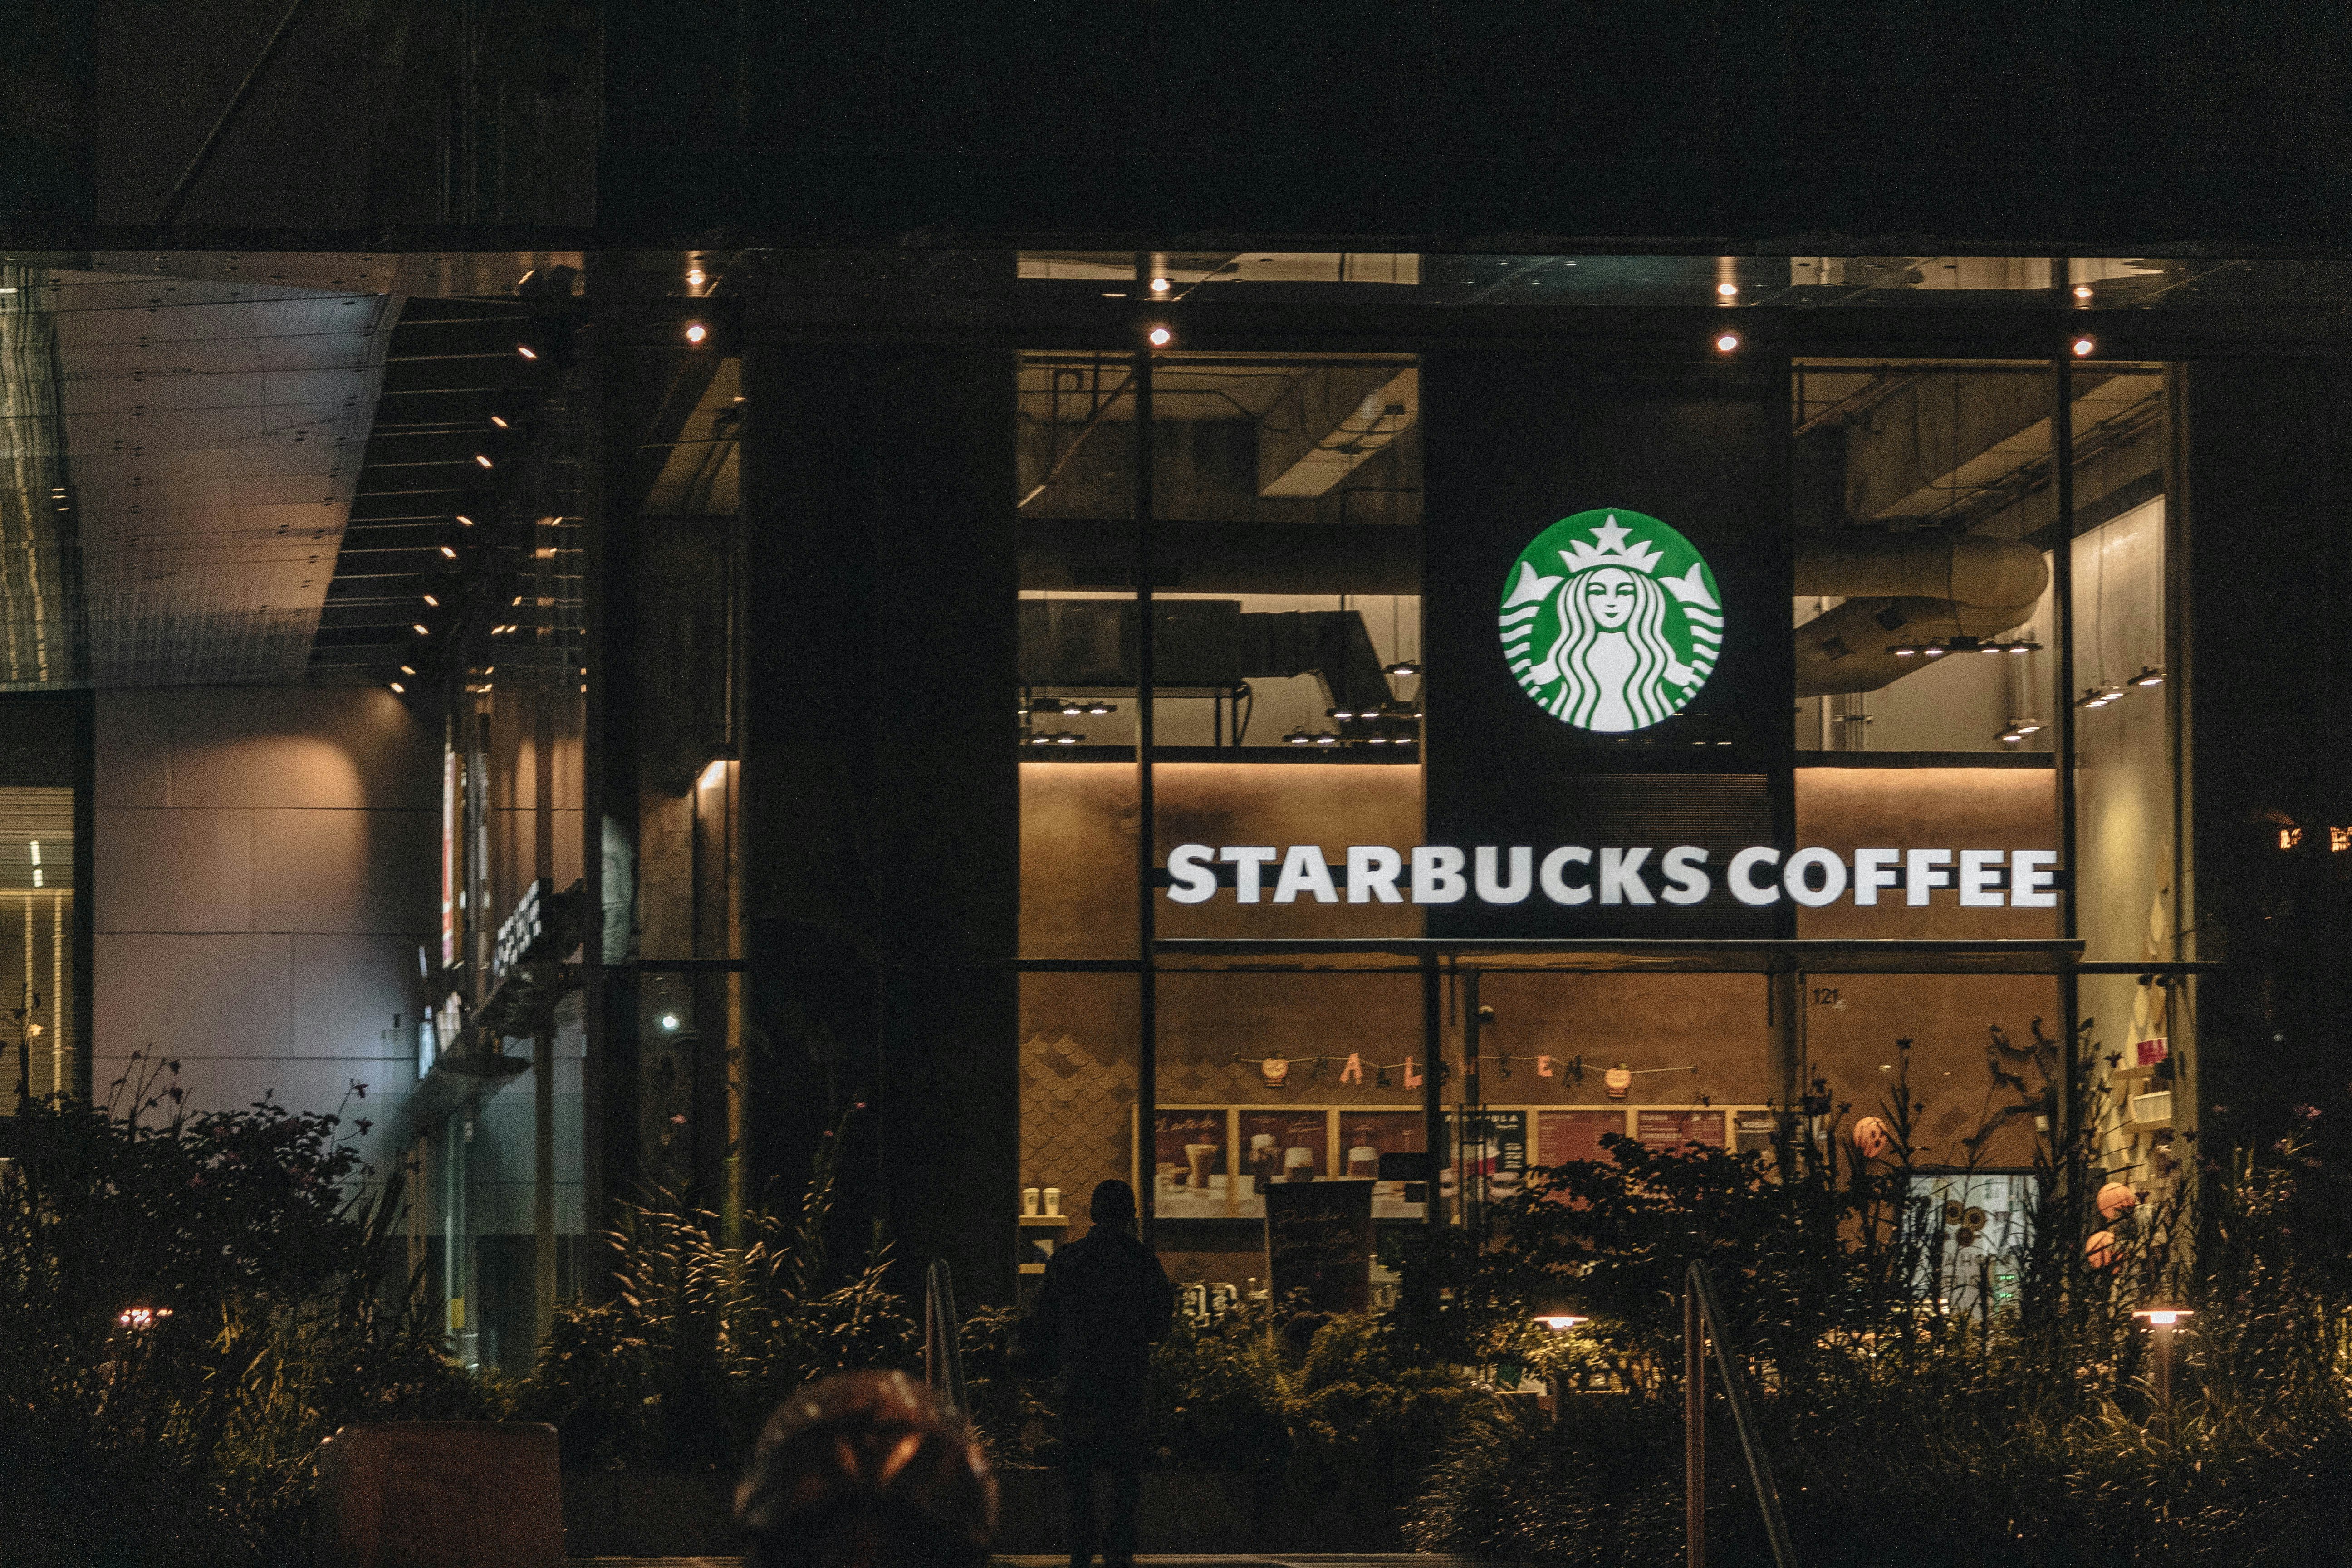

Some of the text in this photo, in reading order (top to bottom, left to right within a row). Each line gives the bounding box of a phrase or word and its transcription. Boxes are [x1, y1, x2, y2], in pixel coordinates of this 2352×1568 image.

[1166, 843, 2057, 907] STARBUCKS COFFEE
[1813, 988, 1838, 1004] 121
